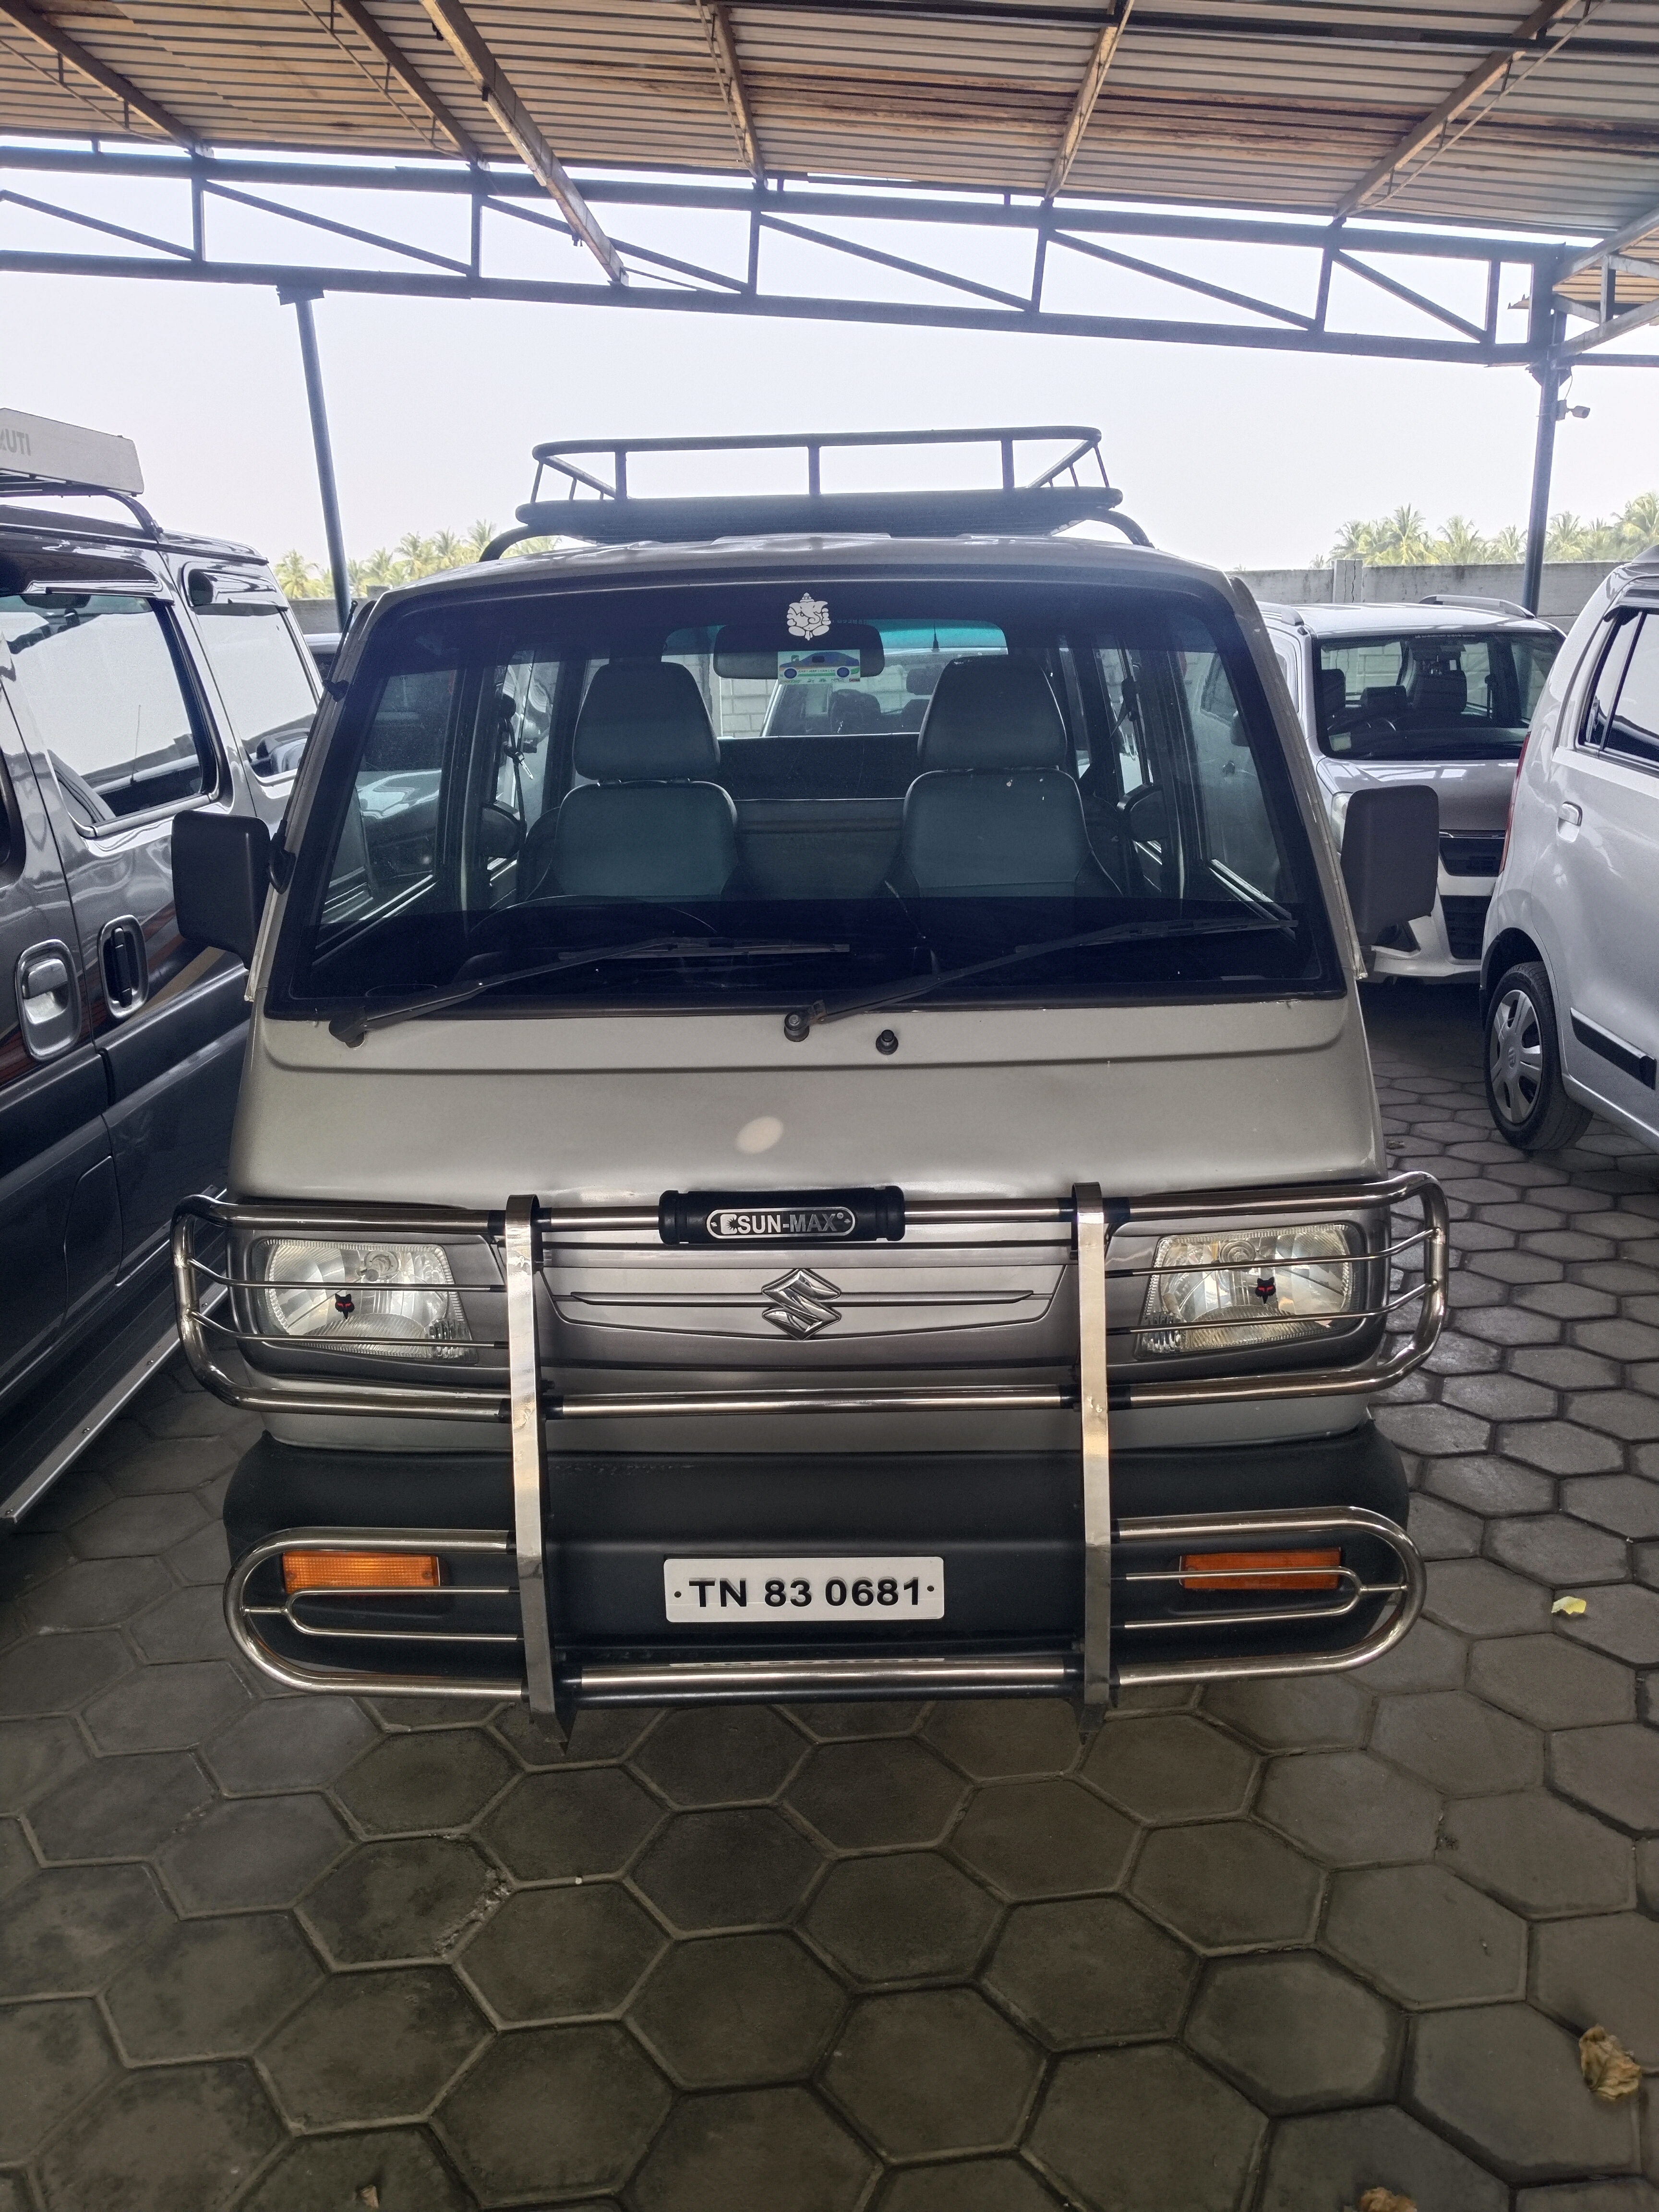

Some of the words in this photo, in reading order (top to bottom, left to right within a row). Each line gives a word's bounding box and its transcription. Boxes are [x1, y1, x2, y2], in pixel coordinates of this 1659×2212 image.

[688, 1578, 748, 1608] TN
[764, 1577, 813, 1607] 83
[825, 1576, 920, 1606] 0681
